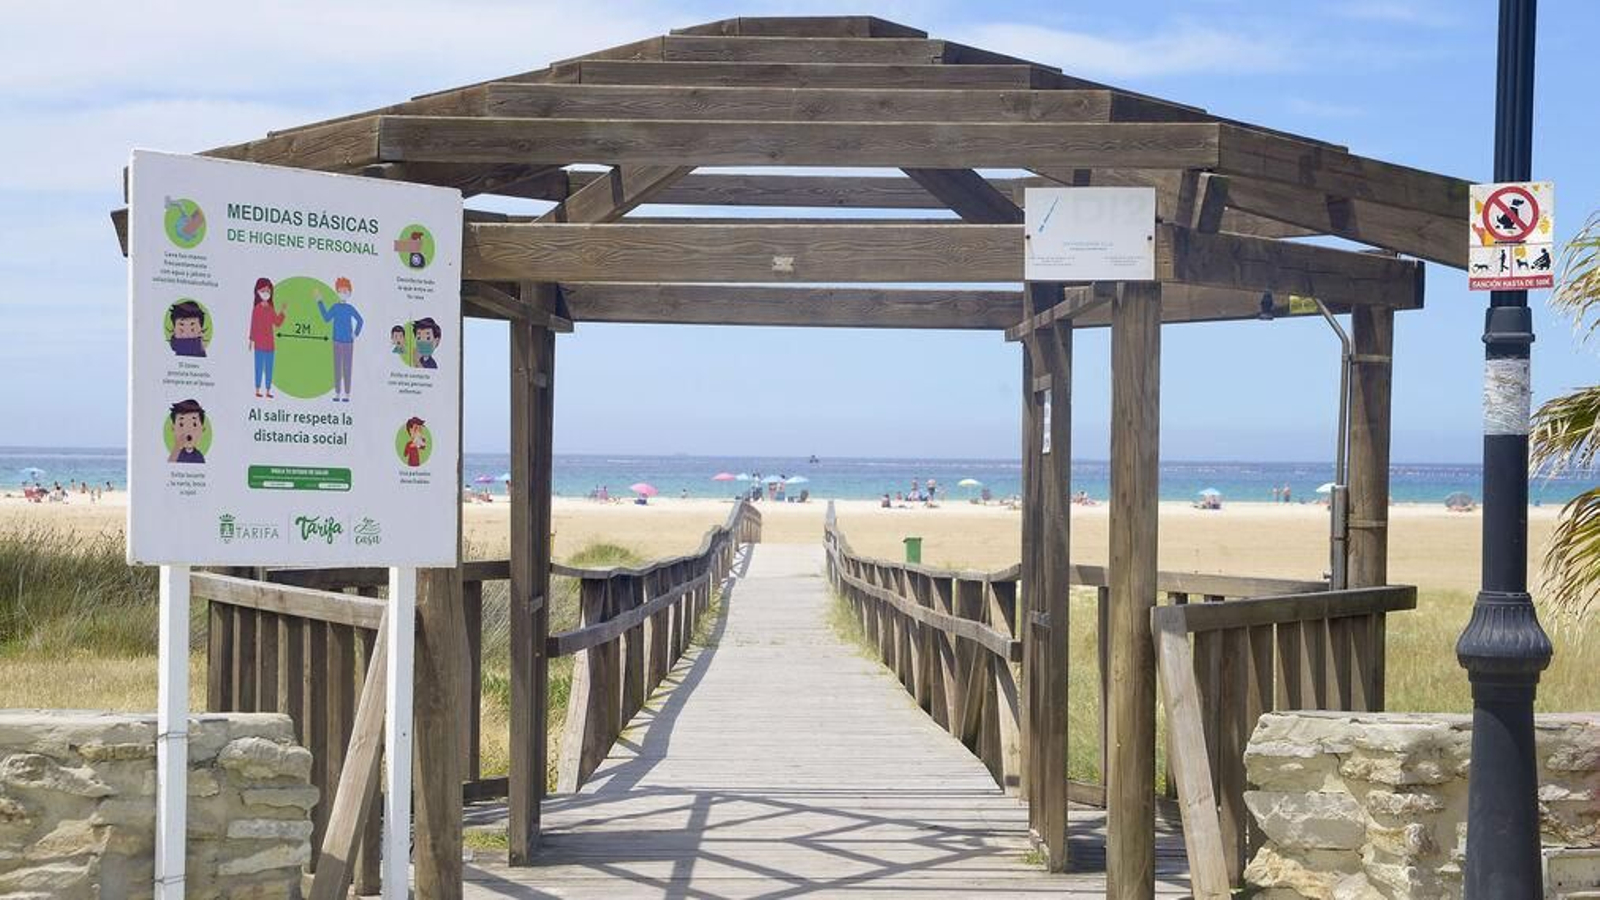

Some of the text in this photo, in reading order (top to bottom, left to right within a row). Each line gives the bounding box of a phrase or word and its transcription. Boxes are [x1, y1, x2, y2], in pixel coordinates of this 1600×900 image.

[227, 203, 379, 234] MEDIDAS BÁSICAS
[227, 228, 379, 255] DE HIGIENE PERSONAL
[1472, 280, 1501, 288] SANCIÓN
[295, 323, 311, 335] 2M
[248, 408, 353, 426] Al salir respeta la
[254, 428, 347, 445] distancia social
[235, 527, 279, 540] TARIFA
[295, 516, 343, 544] Tarifa
[355, 535, 381, 545] casa
